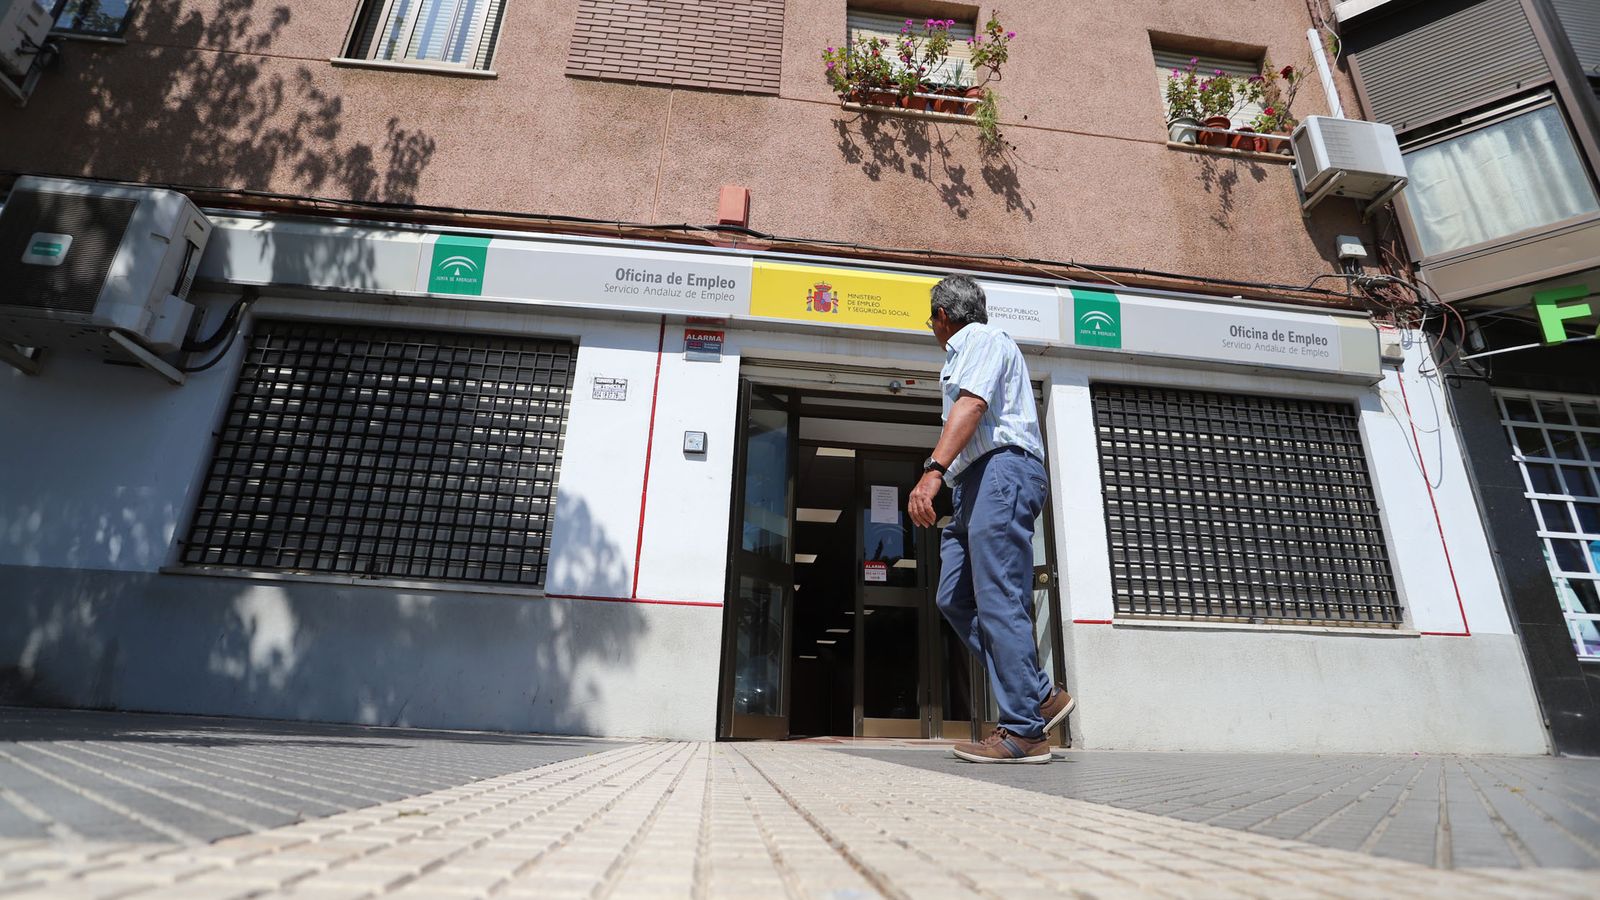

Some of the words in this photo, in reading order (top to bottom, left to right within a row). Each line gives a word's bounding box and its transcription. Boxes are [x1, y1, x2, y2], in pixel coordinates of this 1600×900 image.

[615, 267, 663, 284] Oficina
[666, 272, 683, 285] de
[687, 273, 736, 290] Empleo
[604, 283, 640, 295] Servicio
[643, 286, 682, 298] Andaluz
[685, 289, 697, 299] de
[701, 290, 736, 302] Empleo
[847, 293, 882, 301] MINISTERIO
[853, 306, 888, 315] SEGURIDAD
[888, 309, 910, 317] SOCIAL
[987, 305, 1013, 313] SERVICIO
[1533, 284, 1600, 346] F
[995, 312, 1018, 320] EMPLEO
[1018, 315, 1041, 323] ESTATAL
[686, 333, 722, 342] ALARMA
[1229, 325, 1269, 341] Oficina
[1272, 330, 1285, 342] de
[1289, 331, 1328, 347] Empleo
[1222, 339, 1252, 350] Servicio
[1255, 342, 1286, 354] Andaluz
[1289, 346, 1299, 355] de
[1301, 346, 1329, 358] Empleo
